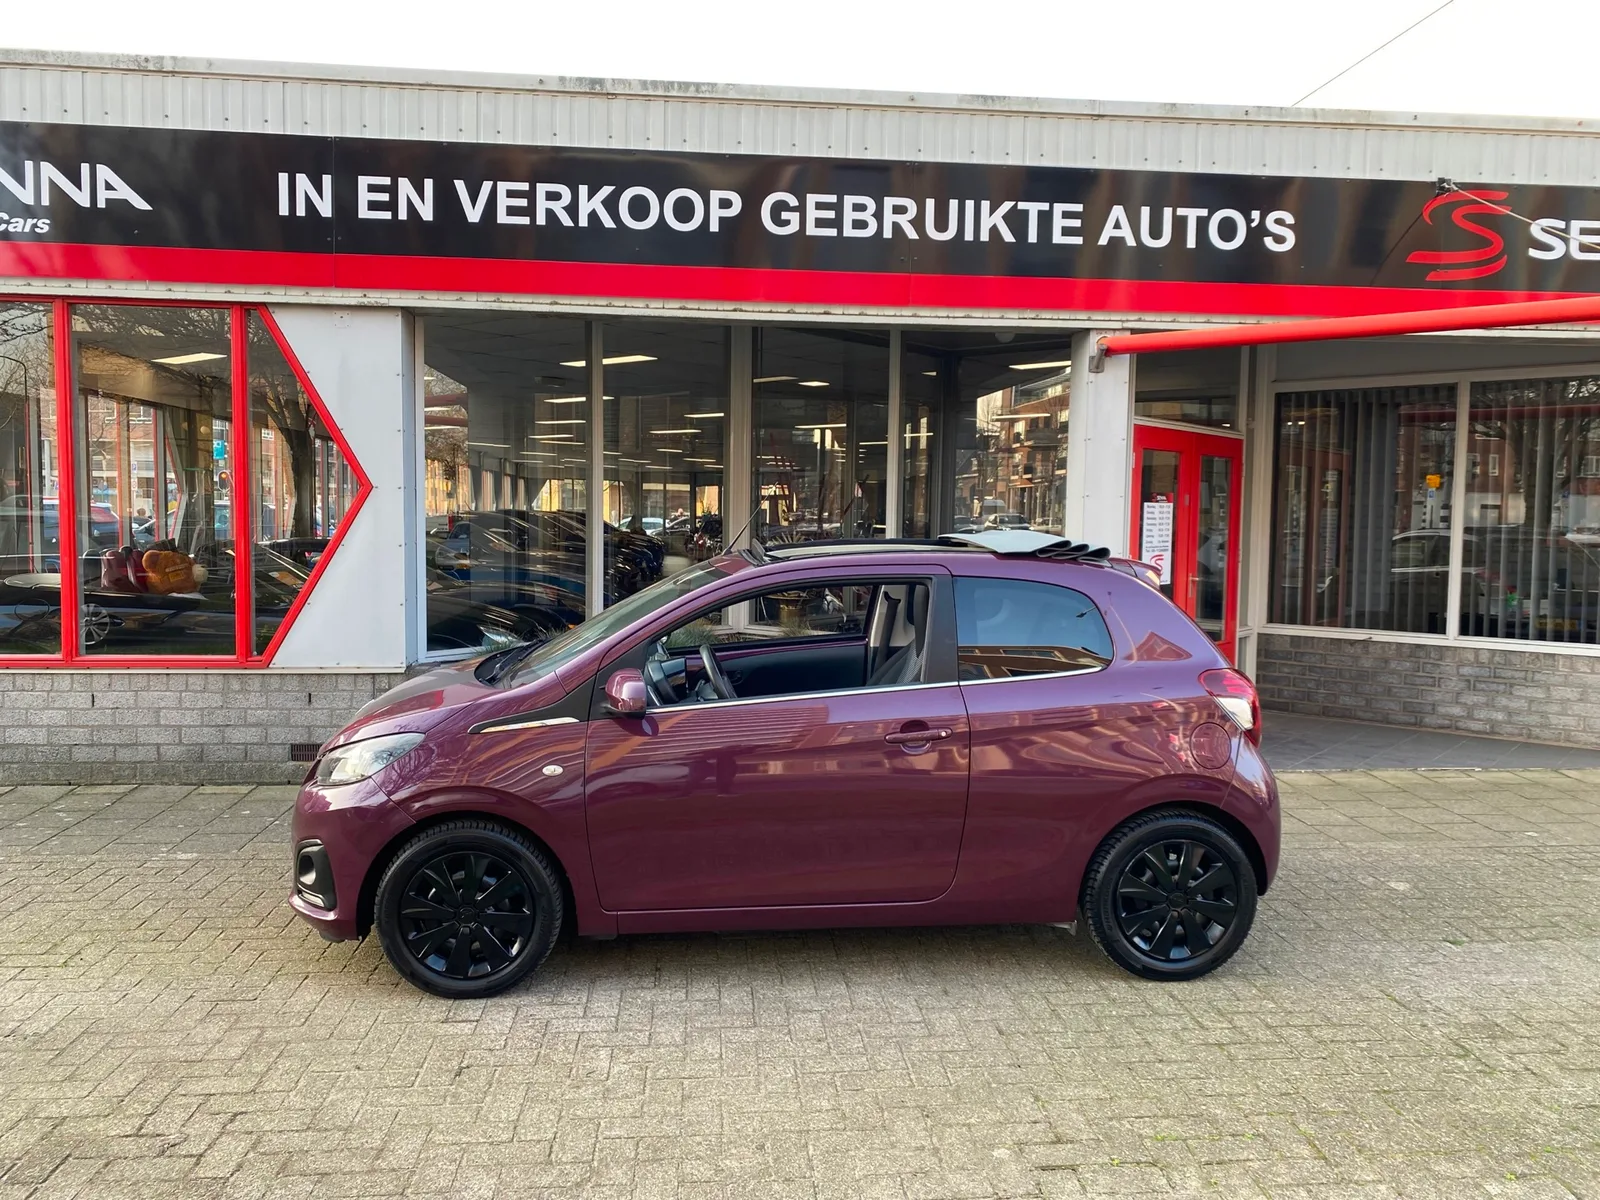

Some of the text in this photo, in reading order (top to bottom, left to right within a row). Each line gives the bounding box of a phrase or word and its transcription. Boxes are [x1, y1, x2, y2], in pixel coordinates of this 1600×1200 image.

[278, 172, 333, 218] IN
[357, 175, 434, 222] EN
[453, 179, 743, 233] VERKOOP
[760, 191, 1084, 245] GEBRUIKTE
